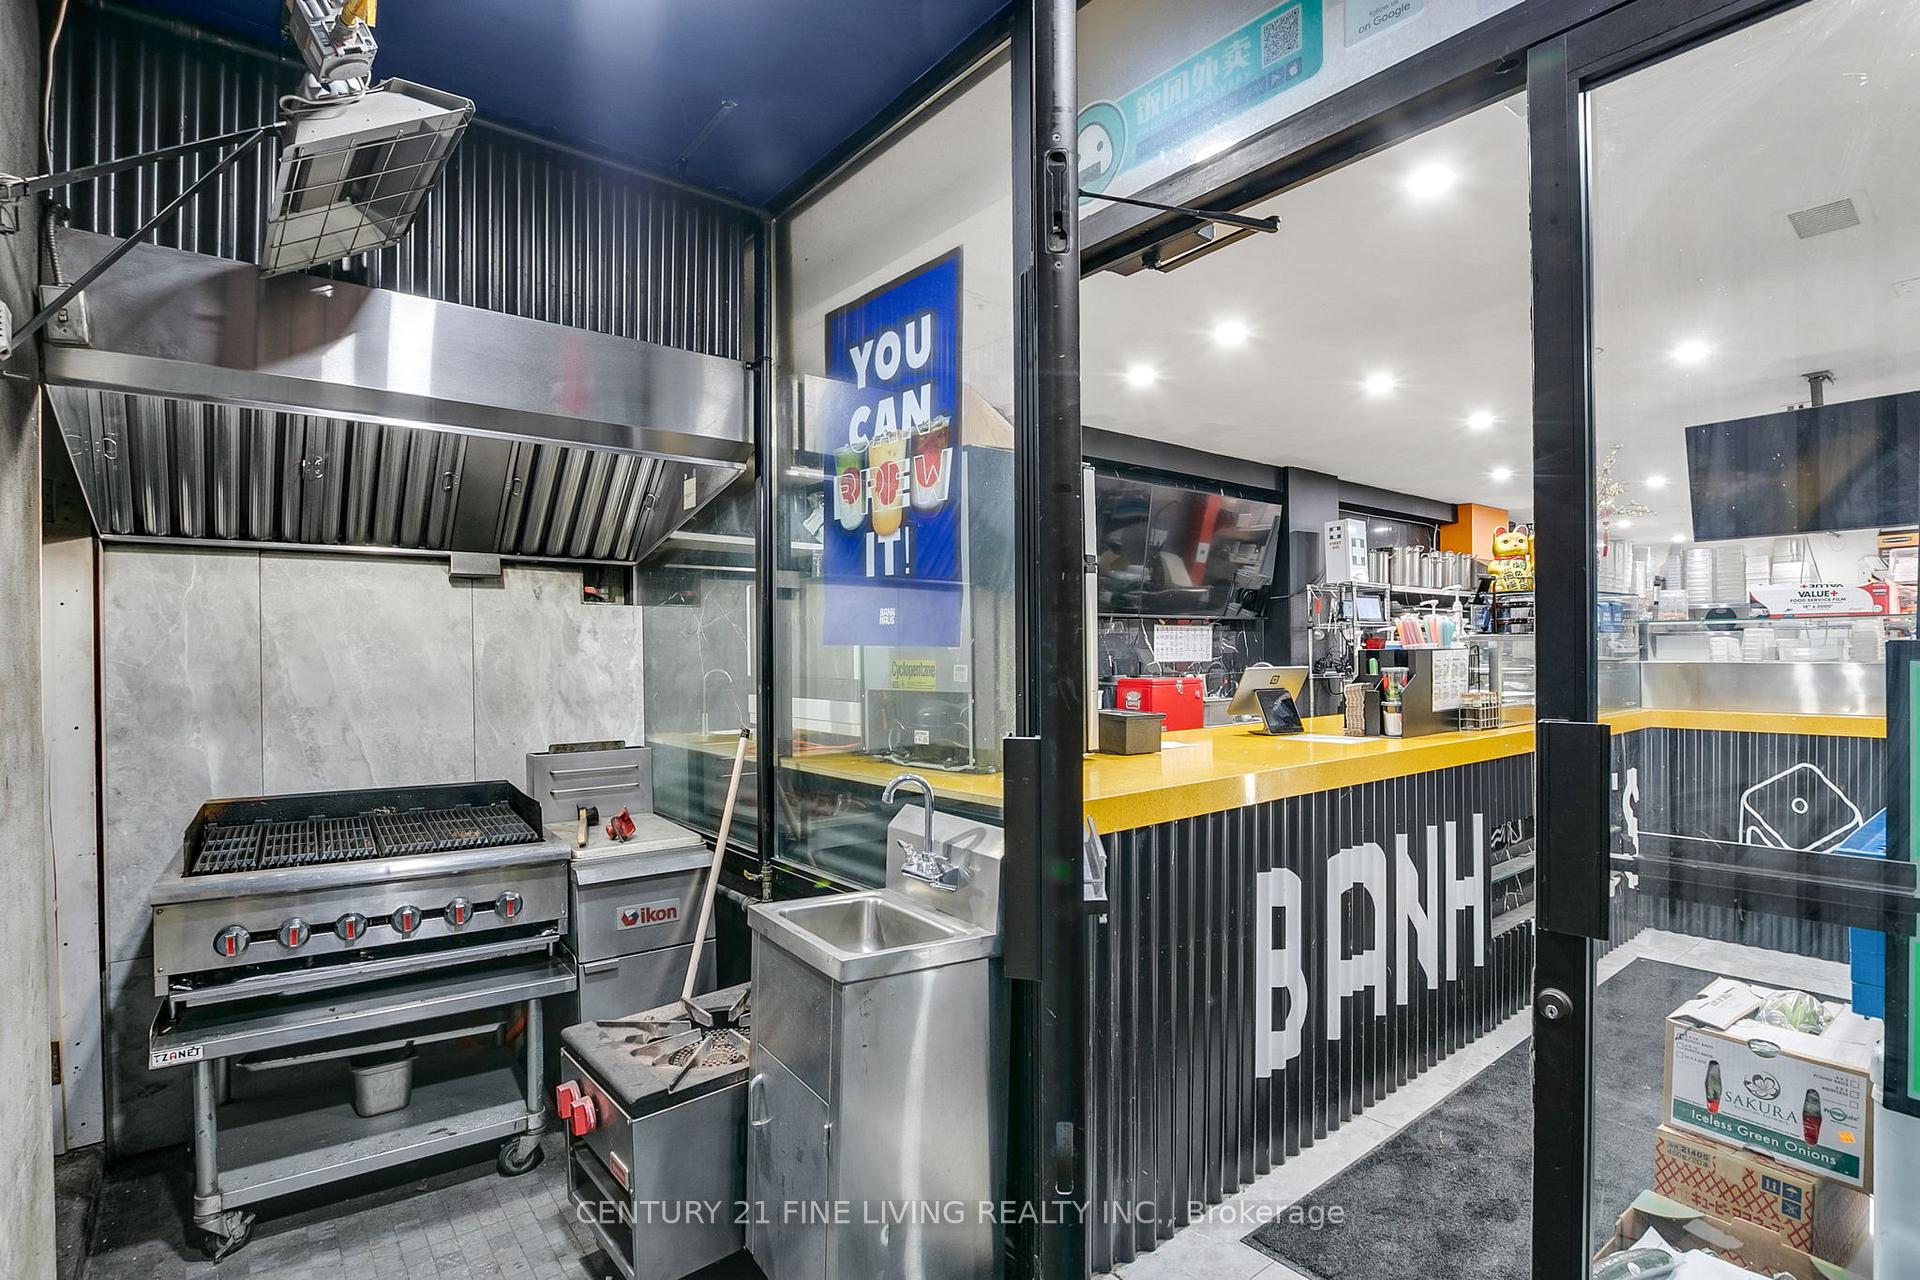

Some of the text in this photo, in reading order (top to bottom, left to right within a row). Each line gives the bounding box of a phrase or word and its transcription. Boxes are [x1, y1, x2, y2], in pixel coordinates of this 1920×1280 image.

[1358, 2, 1411, 34] on Google
[849, 313, 932, 390] YOU
[848, 383, 932, 454] CAN
[833, 447, 954, 521] BREW
[865, 526, 911, 578] IT!
[891, 660, 936, 680] Cyclopentane
[640, 906, 678, 924] ikon
[1255, 812, 1485, 1079] BANH
[1725, 1090, 1799, 1124] SAKURA
[1691, 1108, 1733, 1132] Iceless
[1737, 1125, 1780, 1148] Green
[1784, 1140, 1837, 1165] Onions
